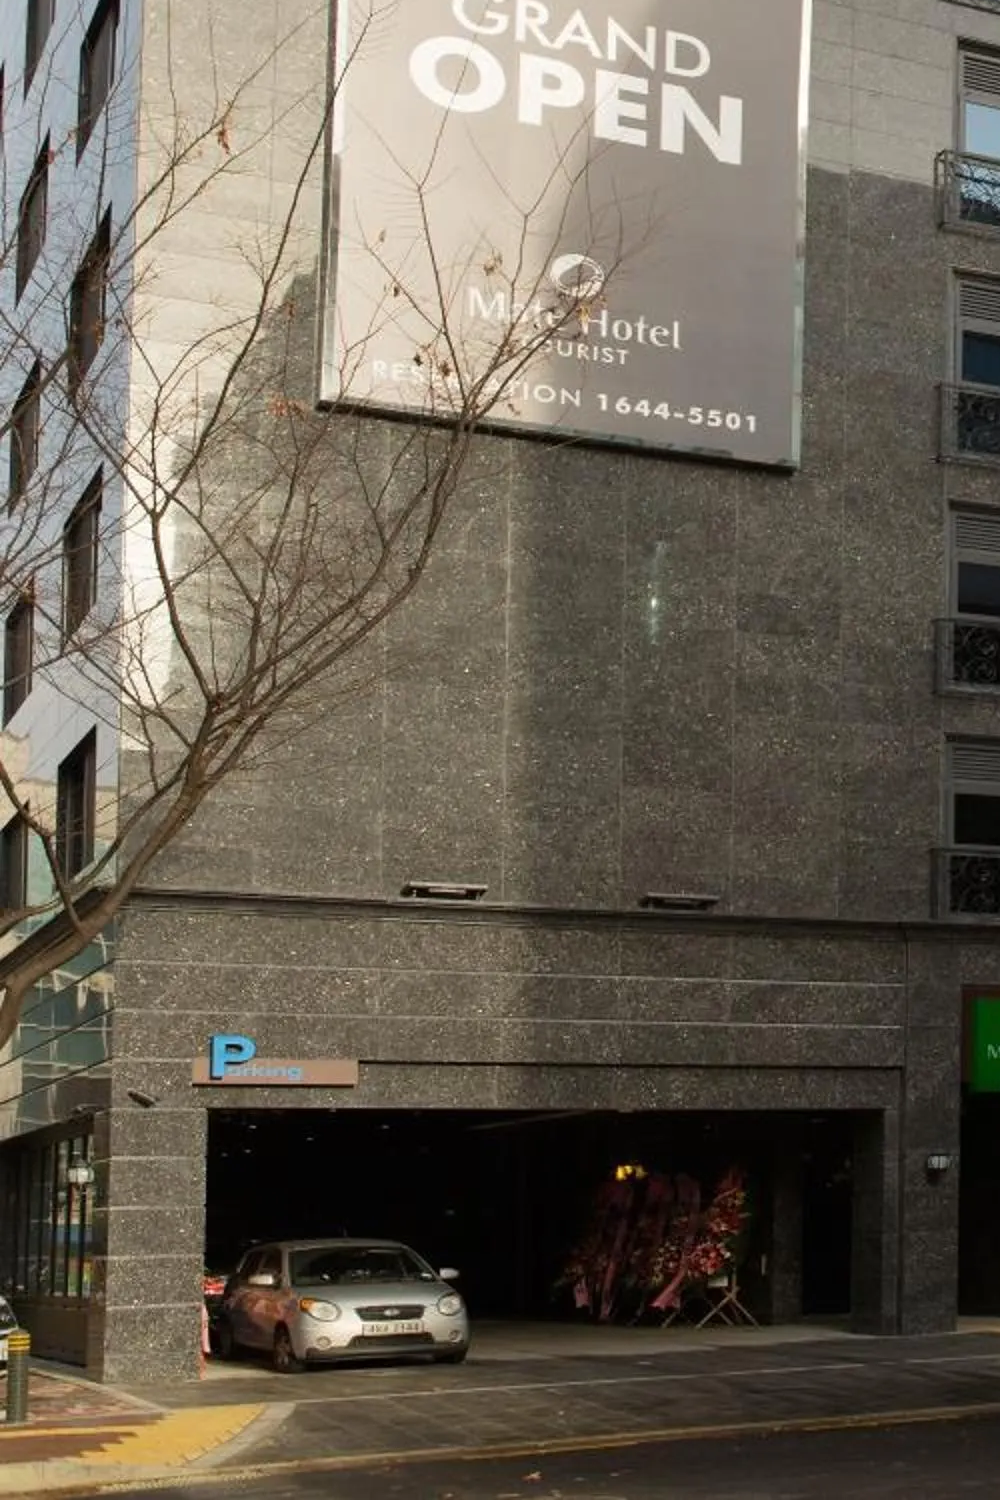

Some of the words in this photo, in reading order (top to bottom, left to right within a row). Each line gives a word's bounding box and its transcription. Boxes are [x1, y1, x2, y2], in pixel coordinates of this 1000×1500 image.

[408, 35, 743, 166] OPEN
[578, 305, 683, 350] Hotel
[596, 392, 758, 434] 1644-5501
